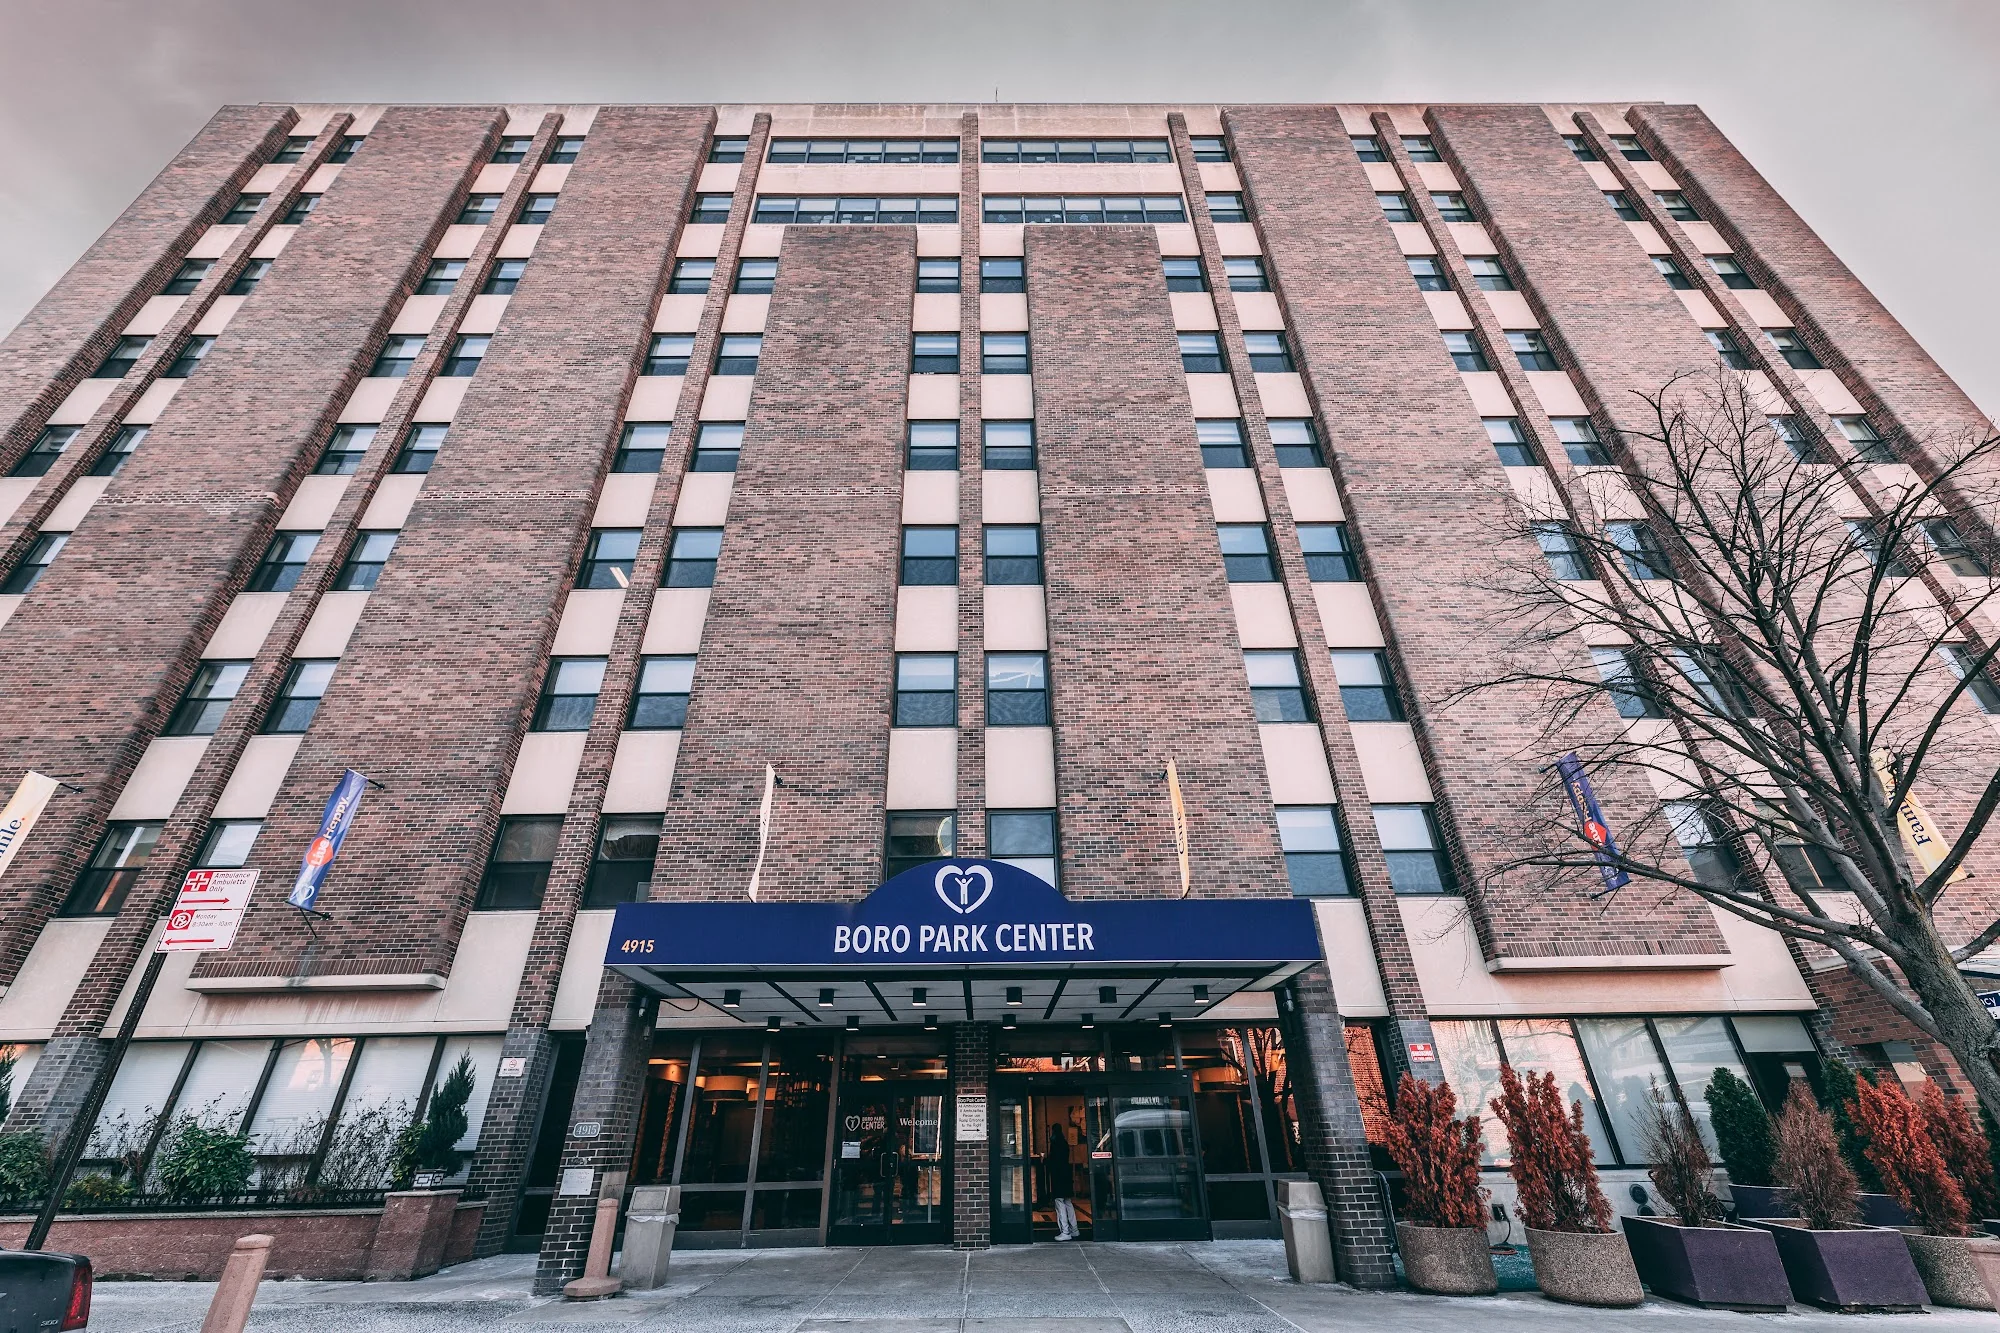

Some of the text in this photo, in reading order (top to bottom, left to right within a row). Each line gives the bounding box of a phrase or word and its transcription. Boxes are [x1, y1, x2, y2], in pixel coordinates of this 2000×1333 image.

[833, 922, 1095, 954] BORO PARK CENTER
[621, 940, 655, 954] 4915
[861, 1121, 885, 1129] CENTER
[900, 1118, 937, 1126] Welcome
[576, 1125, 597, 1135] 4915
